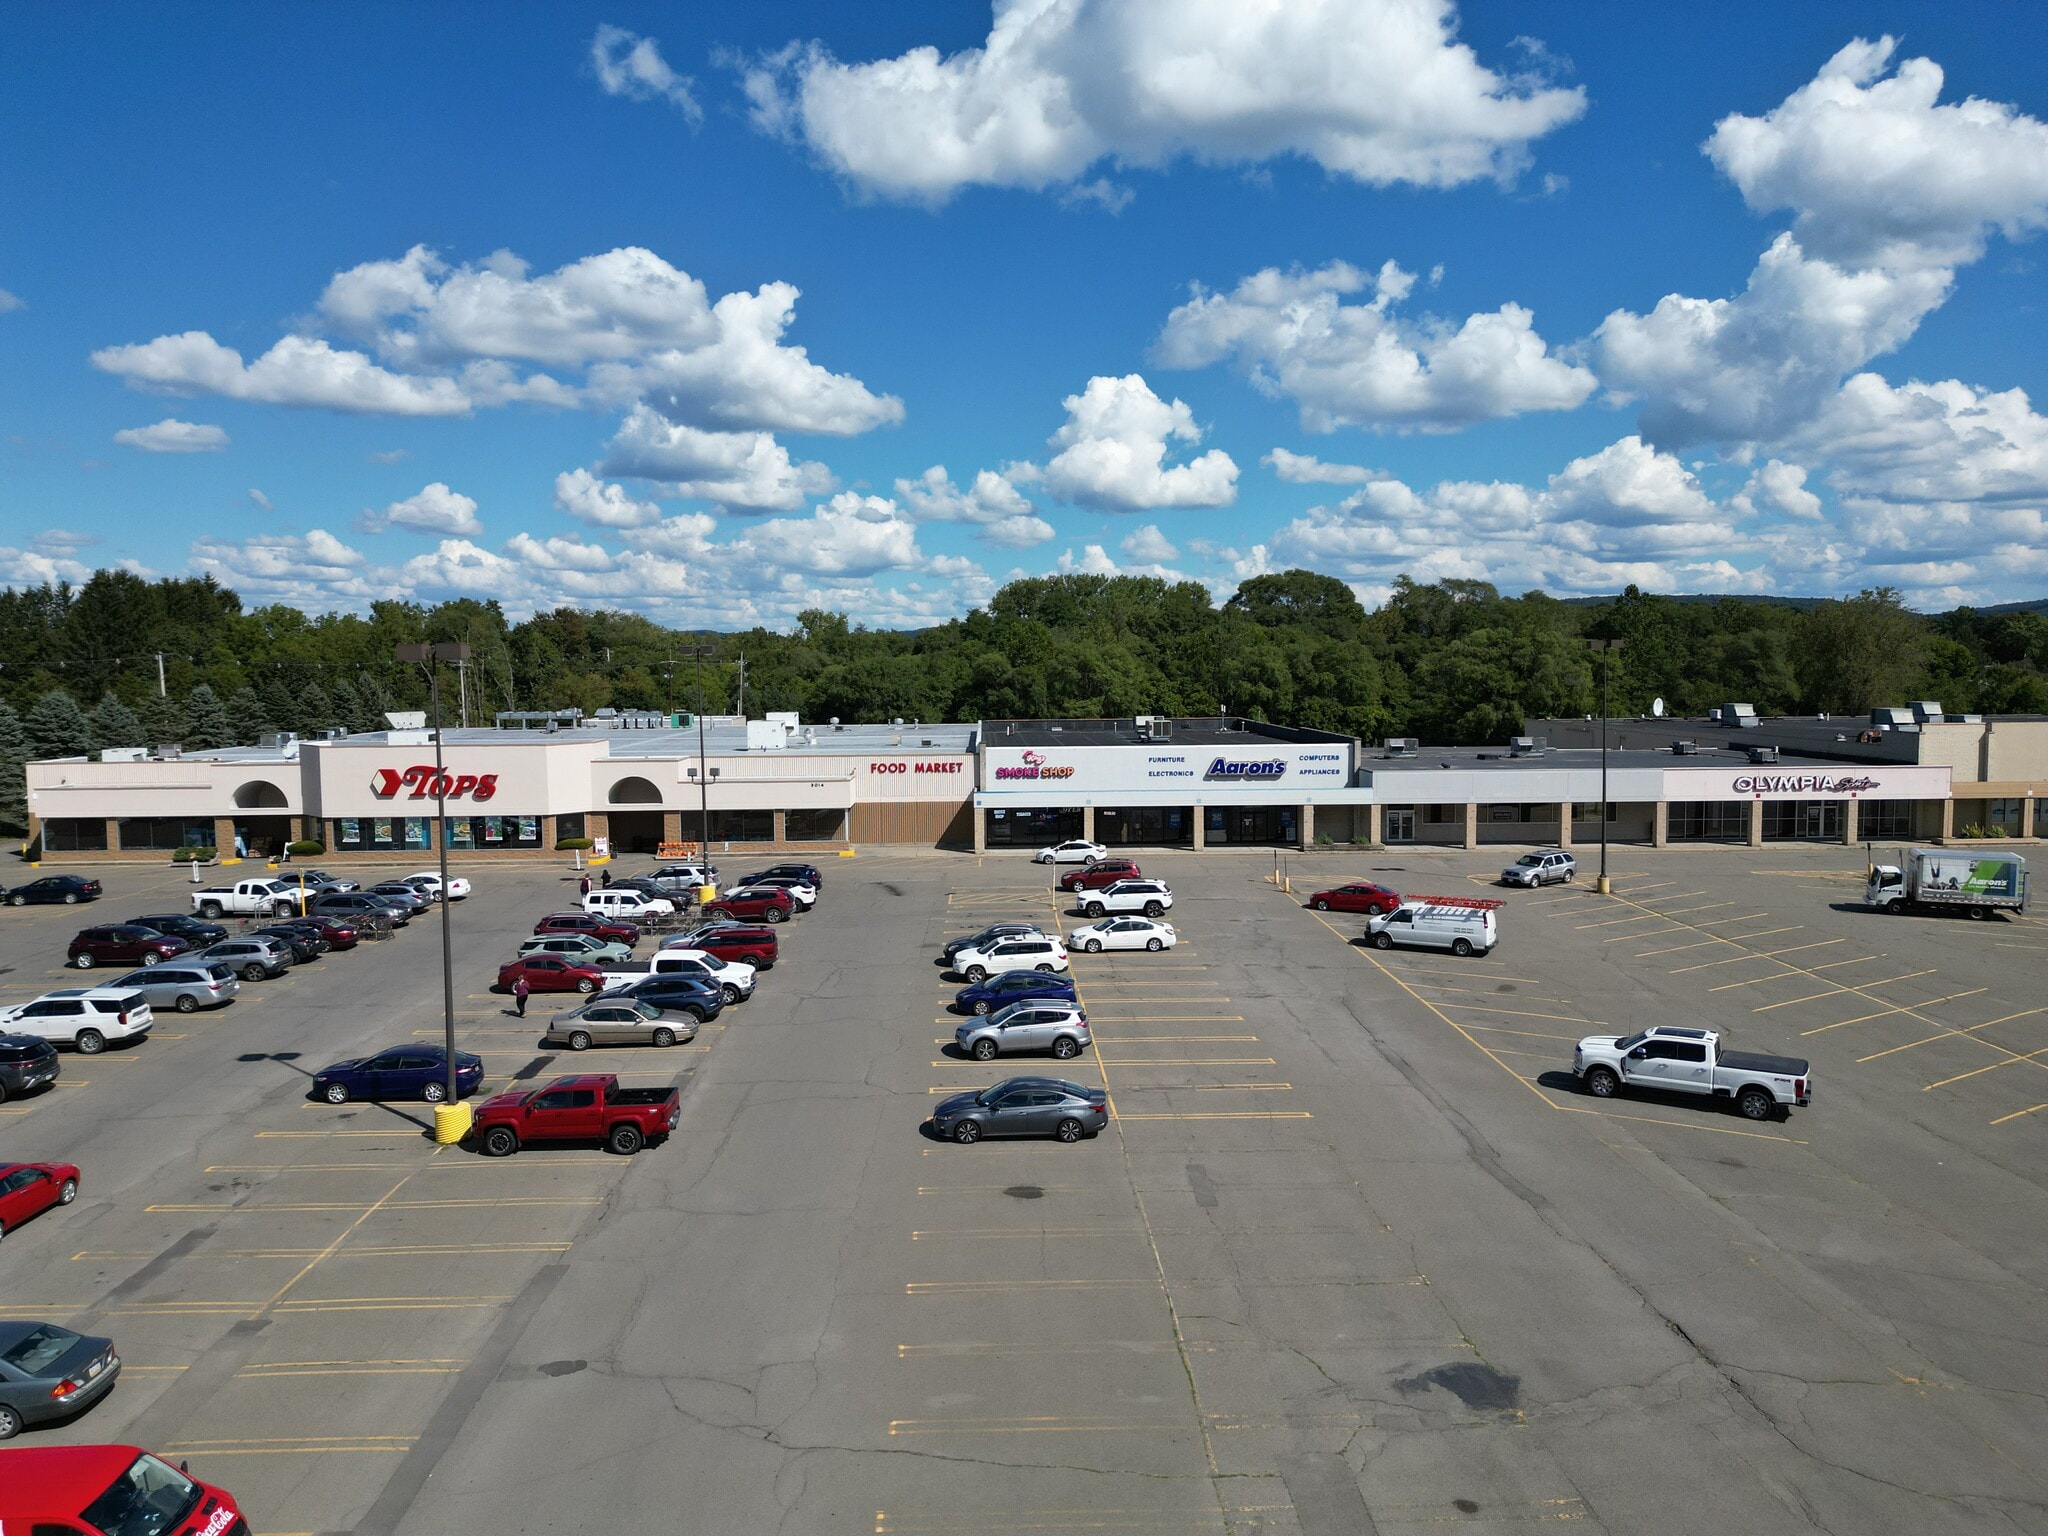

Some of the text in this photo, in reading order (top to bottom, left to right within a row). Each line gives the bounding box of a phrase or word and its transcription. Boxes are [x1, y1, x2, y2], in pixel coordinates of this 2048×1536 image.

[870, 762, 963, 774] FOOD MARKET
[996, 767, 1075, 778] SMOKE SHOP
[1208, 758, 1287, 776] Aaron's
[1734, 776, 1835, 792] OLYMPIA
[1968, 877, 2008, 886] Aaron's
